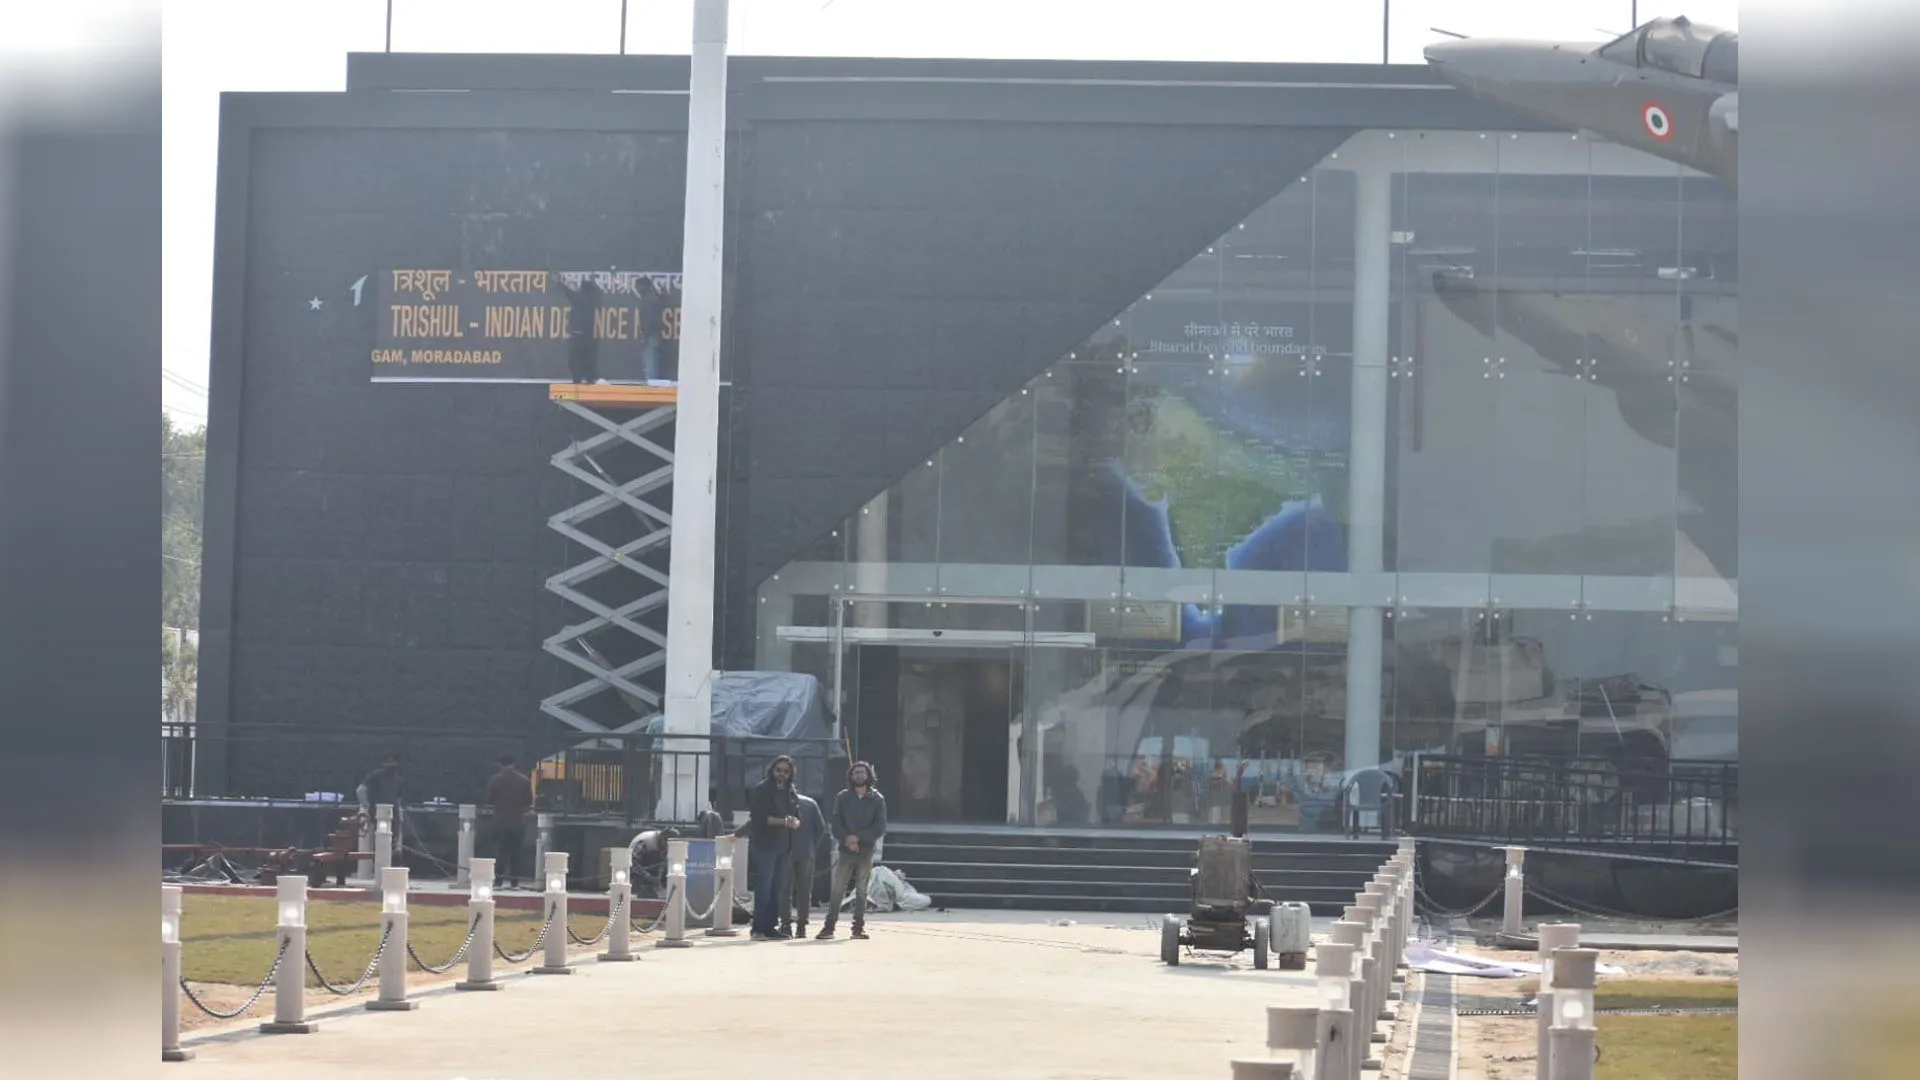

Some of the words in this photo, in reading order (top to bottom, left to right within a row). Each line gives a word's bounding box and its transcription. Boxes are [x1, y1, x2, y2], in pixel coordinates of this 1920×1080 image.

[391, 305, 463, 338] TRISHUL
[485, 306, 544, 339] INDIAN
[550, 307, 628, 340] DENCE
[1230, 321, 1241, 337] से
[1262, 326, 1294, 338] भारत
[1149, 340, 1195, 353] Bharat
[371, 350, 407, 366] GAM,
[411, 350, 502, 364] MORADABAD
